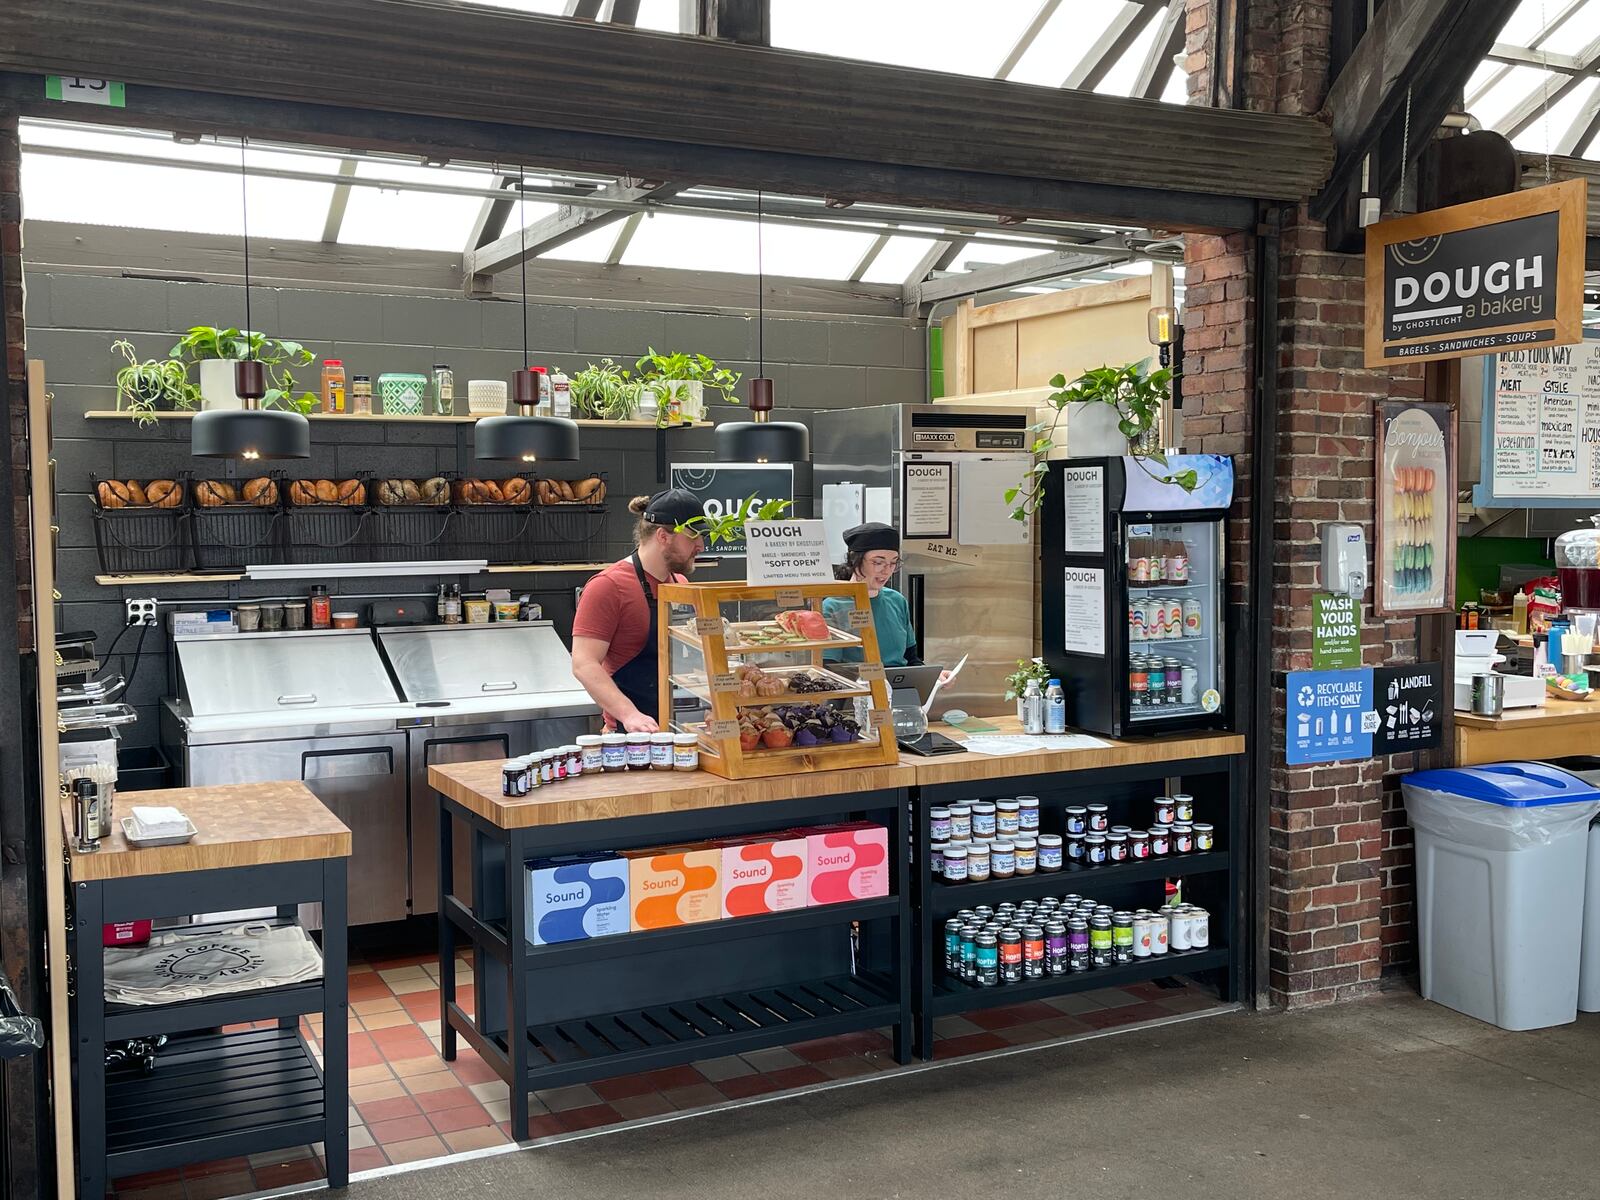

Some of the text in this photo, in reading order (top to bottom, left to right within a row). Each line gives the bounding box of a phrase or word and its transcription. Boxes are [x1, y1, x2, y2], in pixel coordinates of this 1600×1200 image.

[1395, 255, 1543, 308] DOUGH
[1465, 294, 1542, 318] a bakery
[1392, 316, 1462, 332] by GHOSTLIGHT
[1399, 331, 1537, 356] BAGELS SANDWICHES SOUPS
[1551, 346, 1572, 365] WAY
[1500, 379, 1522, 392] MEAT
[1543, 380, 1569, 393] STYLE
[1543, 396, 1573, 406] American
[1541, 420, 1572, 432] mexican
[1497, 435, 1535, 449] vegetarian
[908, 468, 942, 477] DOUGH
[1067, 470, 1098, 482] DOUGH
[750, 526, 802, 538] DOUGH
[927, 542, 958, 556] EAT ME
[1065, 571, 1096, 583] DOUGH
[1320, 598, 1353, 611] WASH
[1320, 612, 1353, 624] YOUR
[1316, 625, 1357, 638] HANDS
[1317, 681, 1363, 695] RECYCLABLE
[1400, 675, 1432, 690] LANDFILL
[1317, 693, 1361, 707] ITEMS ONLY
[1363, 721, 1377, 730] SURE
[817, 853, 850, 866] Sound
[732, 866, 767, 880] Sound
[643, 876, 679, 891] Sound
[546, 888, 584, 904] Sound
